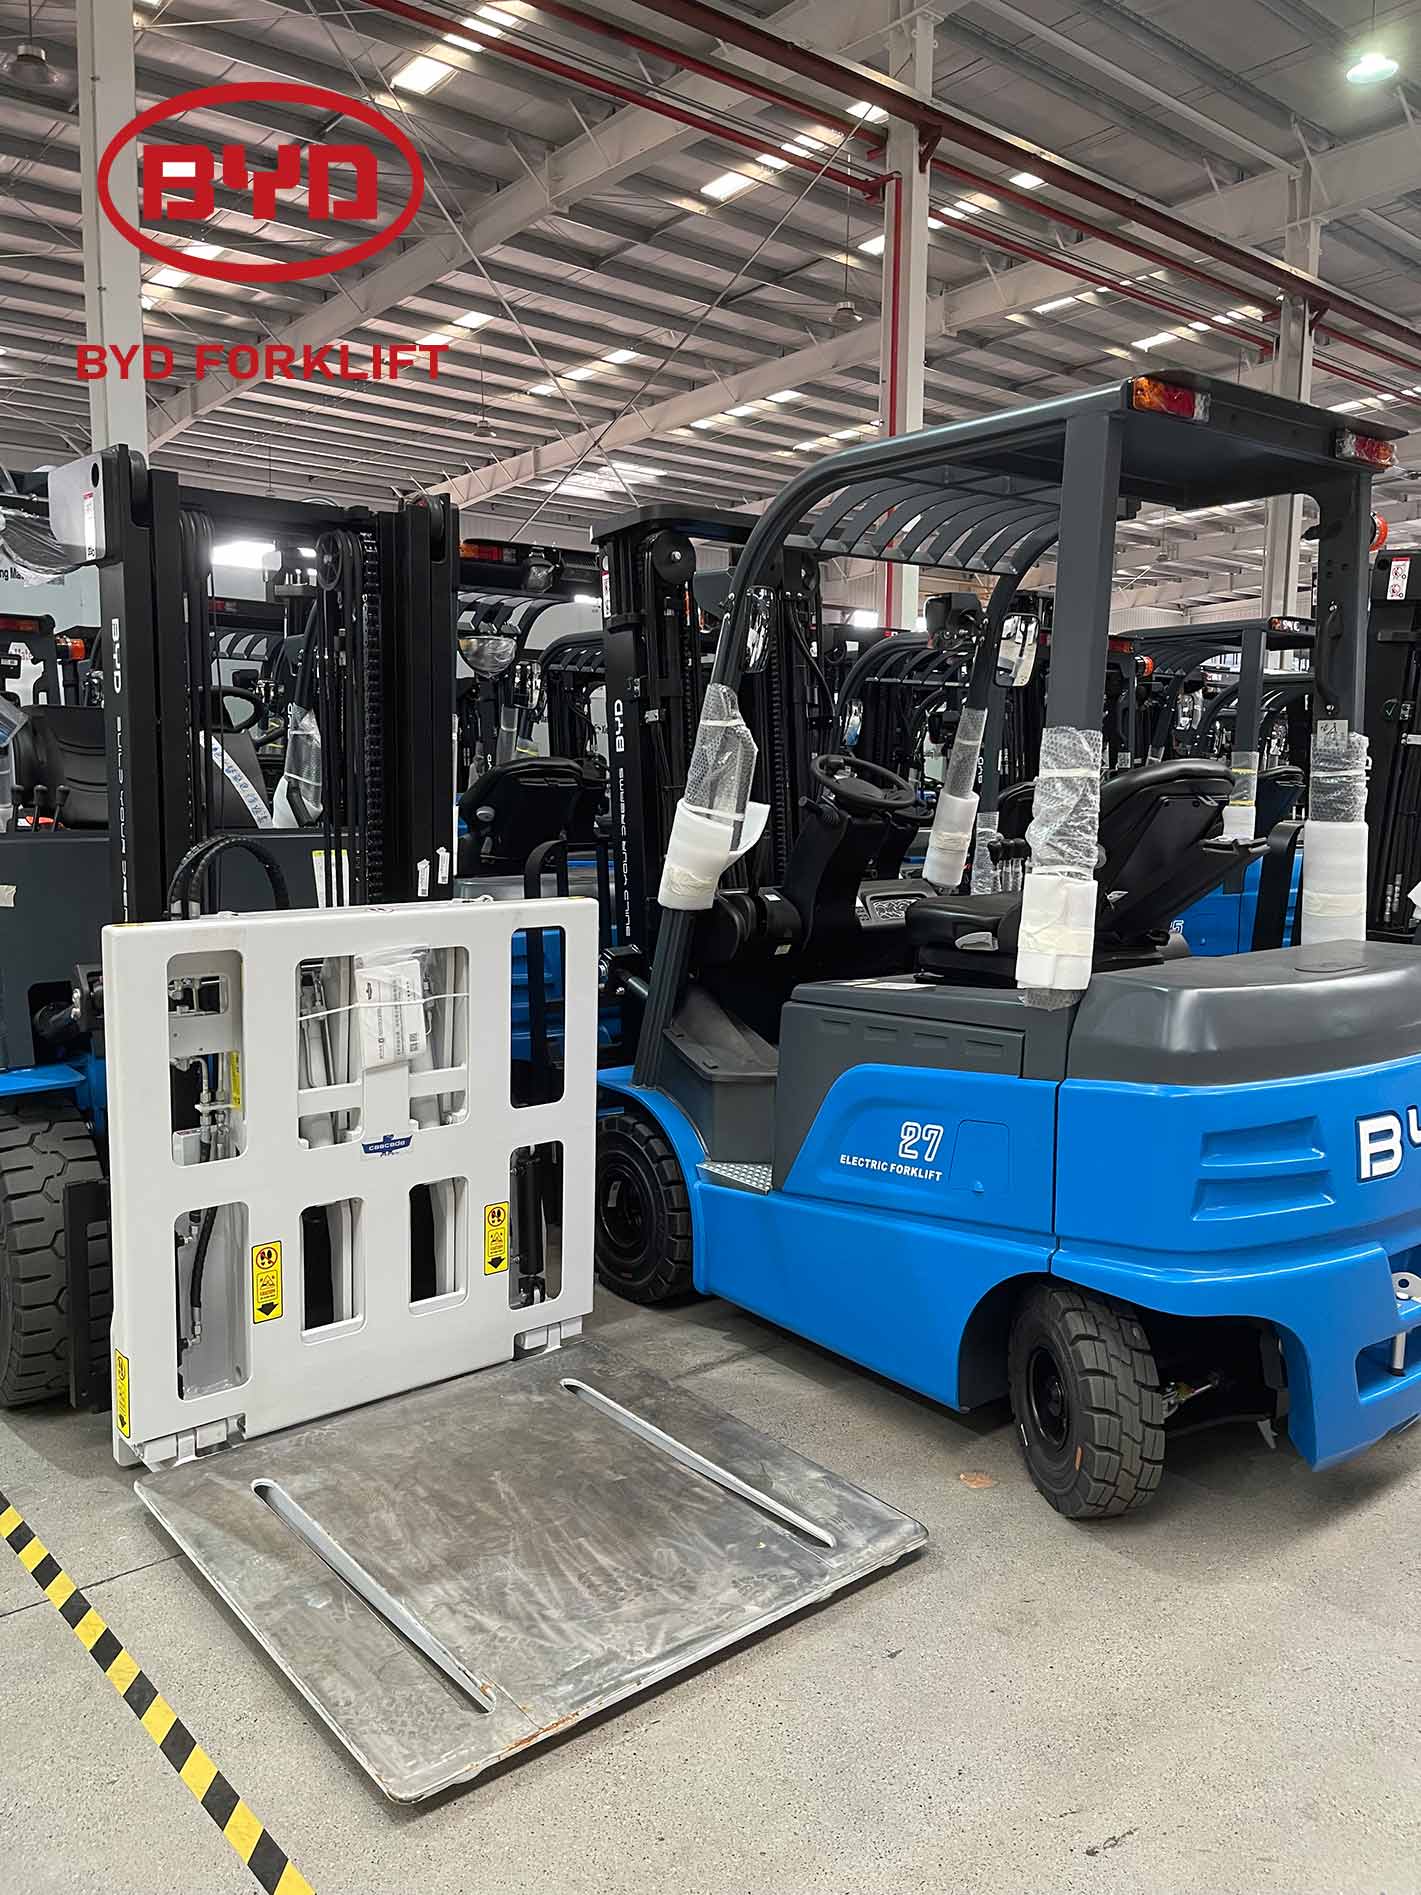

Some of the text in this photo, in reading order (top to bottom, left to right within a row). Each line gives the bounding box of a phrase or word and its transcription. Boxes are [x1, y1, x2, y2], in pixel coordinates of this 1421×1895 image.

[111, 618, 121, 694] BYD
[116, 716, 124, 784] BUILD
[614, 699, 625, 753] BYD
[119, 790, 127, 854] YOUR
[618, 767, 627, 837] DREAMS
[621, 840, 629, 886] YOUR
[840, 1154, 943, 1181] ELECTRIC FORKLIFT
[898, 1121, 944, 1162] 27
